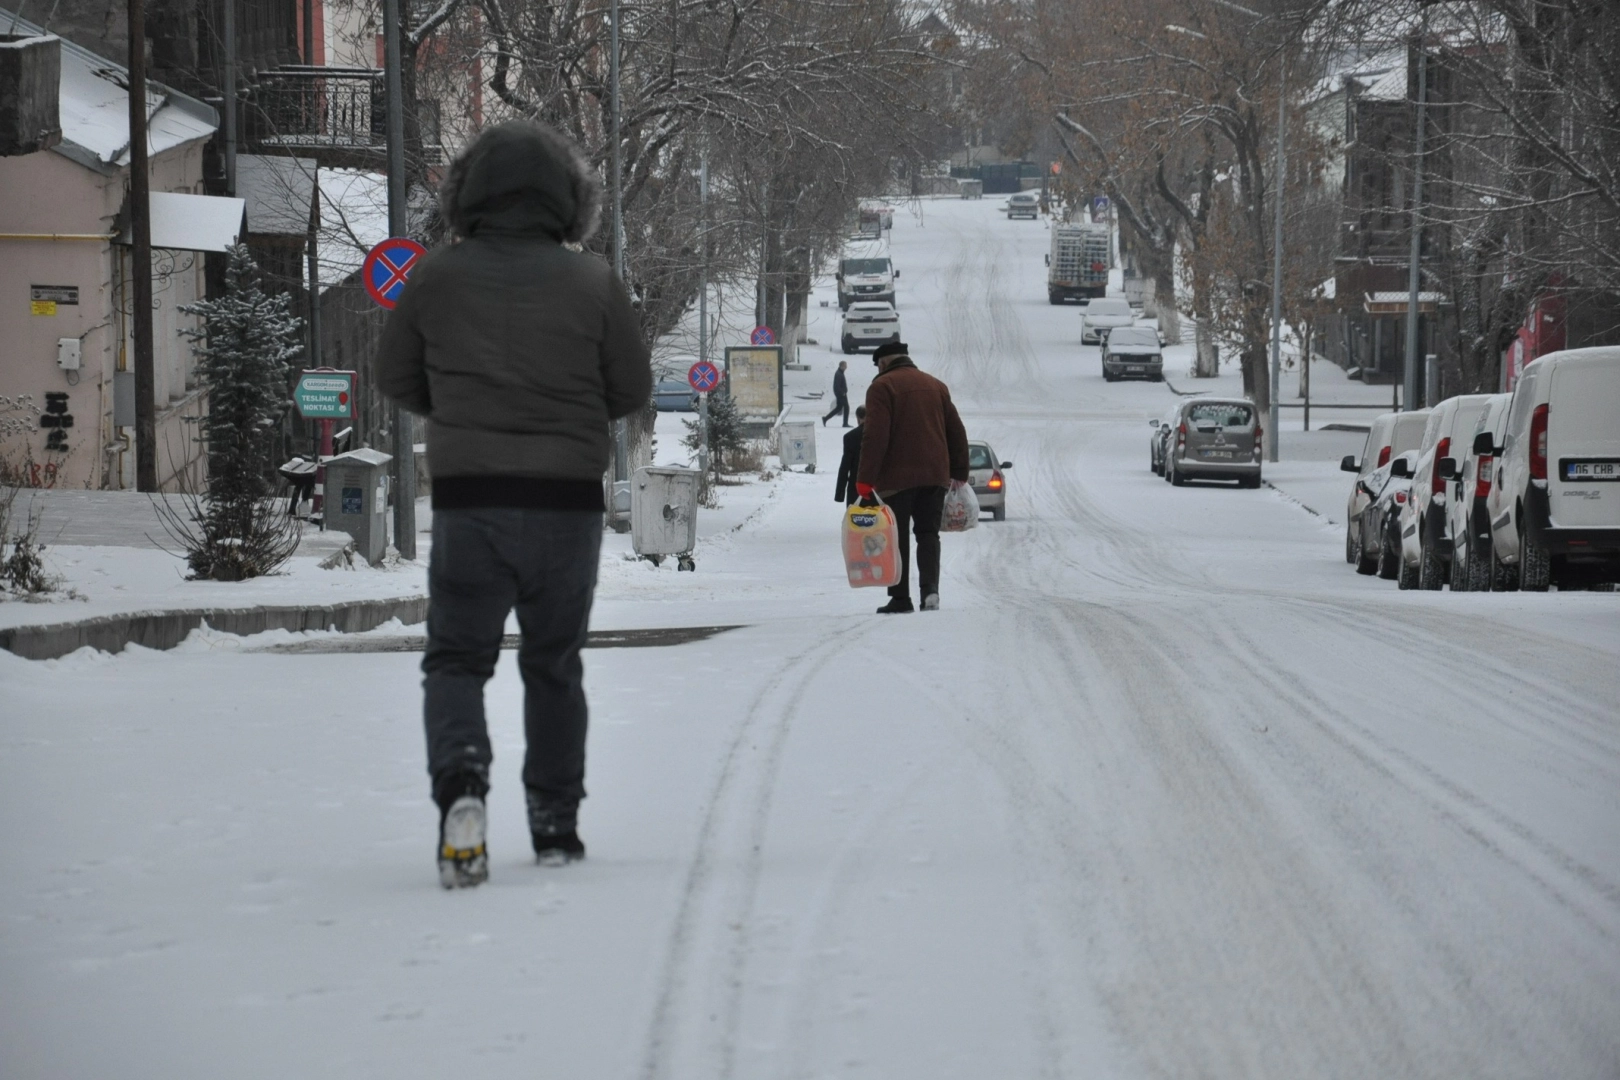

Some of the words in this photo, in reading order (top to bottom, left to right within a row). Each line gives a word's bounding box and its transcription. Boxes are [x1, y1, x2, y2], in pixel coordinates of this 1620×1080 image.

[301, 394, 337, 402] TESLİMAT
[1575, 464, 1589, 474] 06
[1593, 464, 1614, 474] CHB
